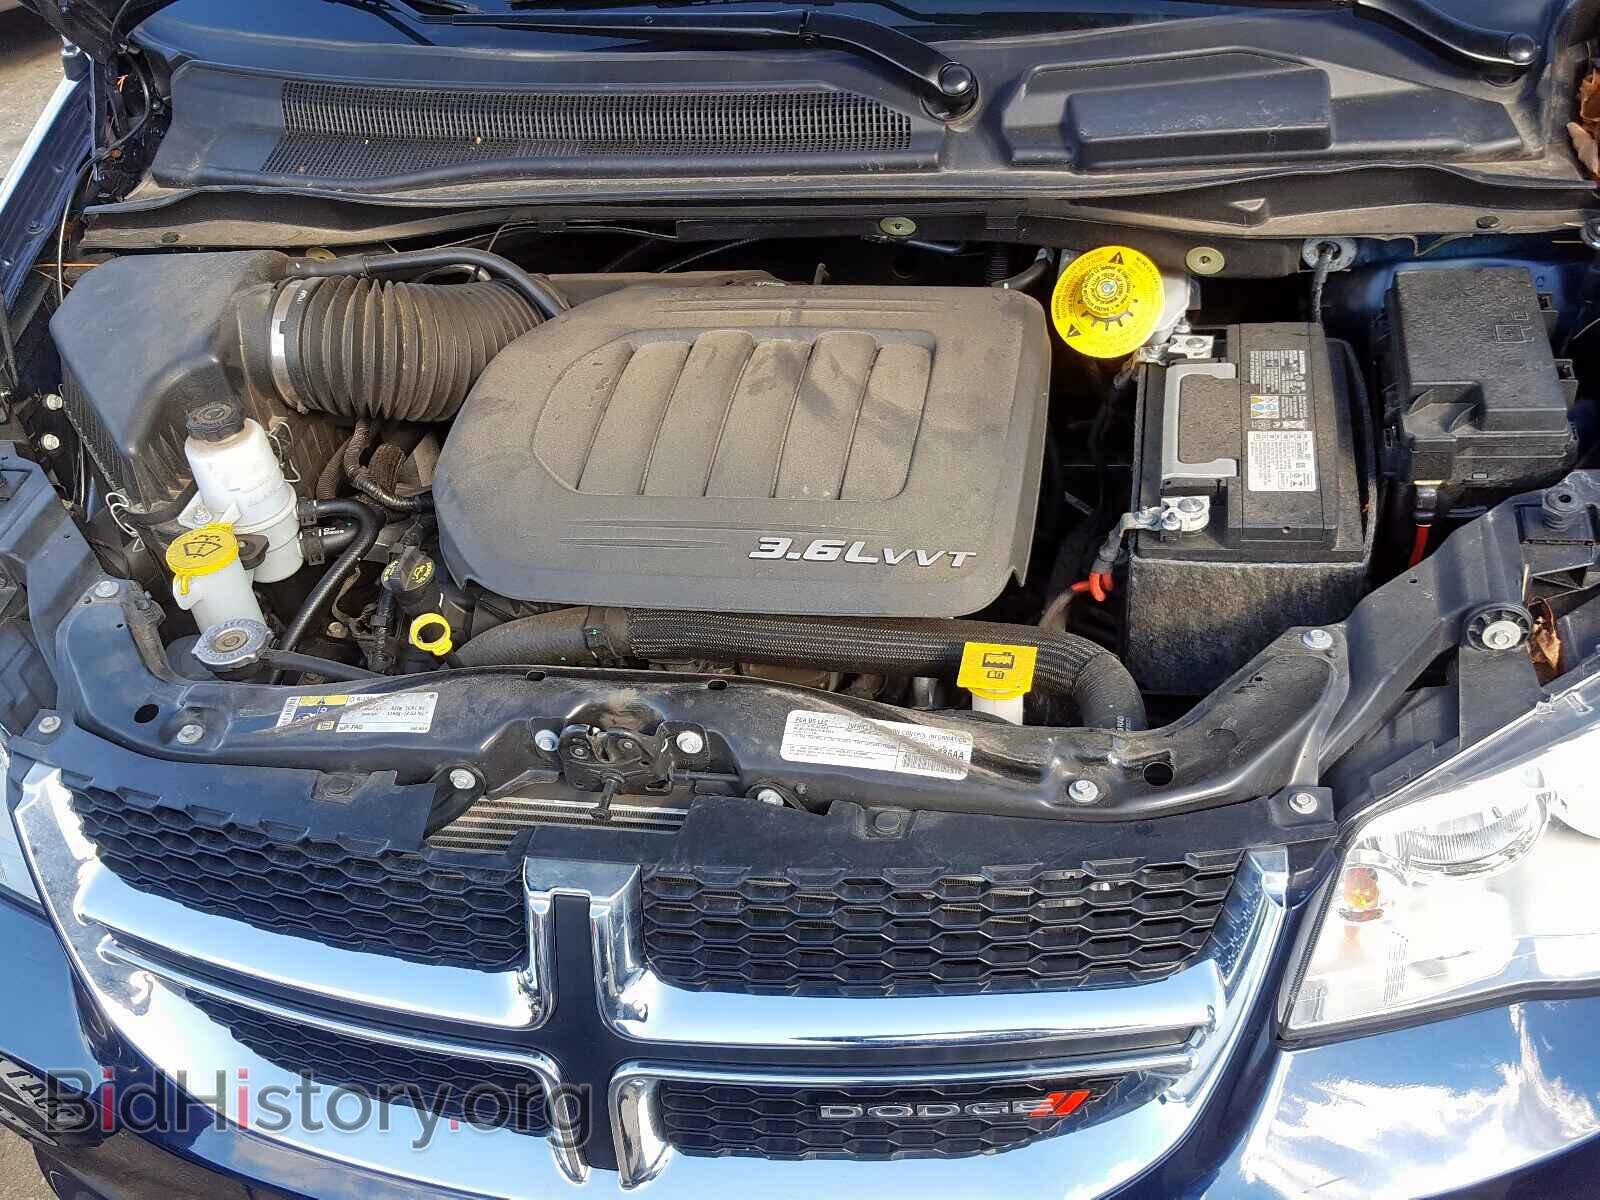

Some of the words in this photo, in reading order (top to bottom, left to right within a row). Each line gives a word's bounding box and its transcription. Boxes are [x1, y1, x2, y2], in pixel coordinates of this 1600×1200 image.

[749, 537, 879, 563] 3.6L
[883, 548, 977, 567] VVT
[820, 1099, 1054, 1119] DODGE
